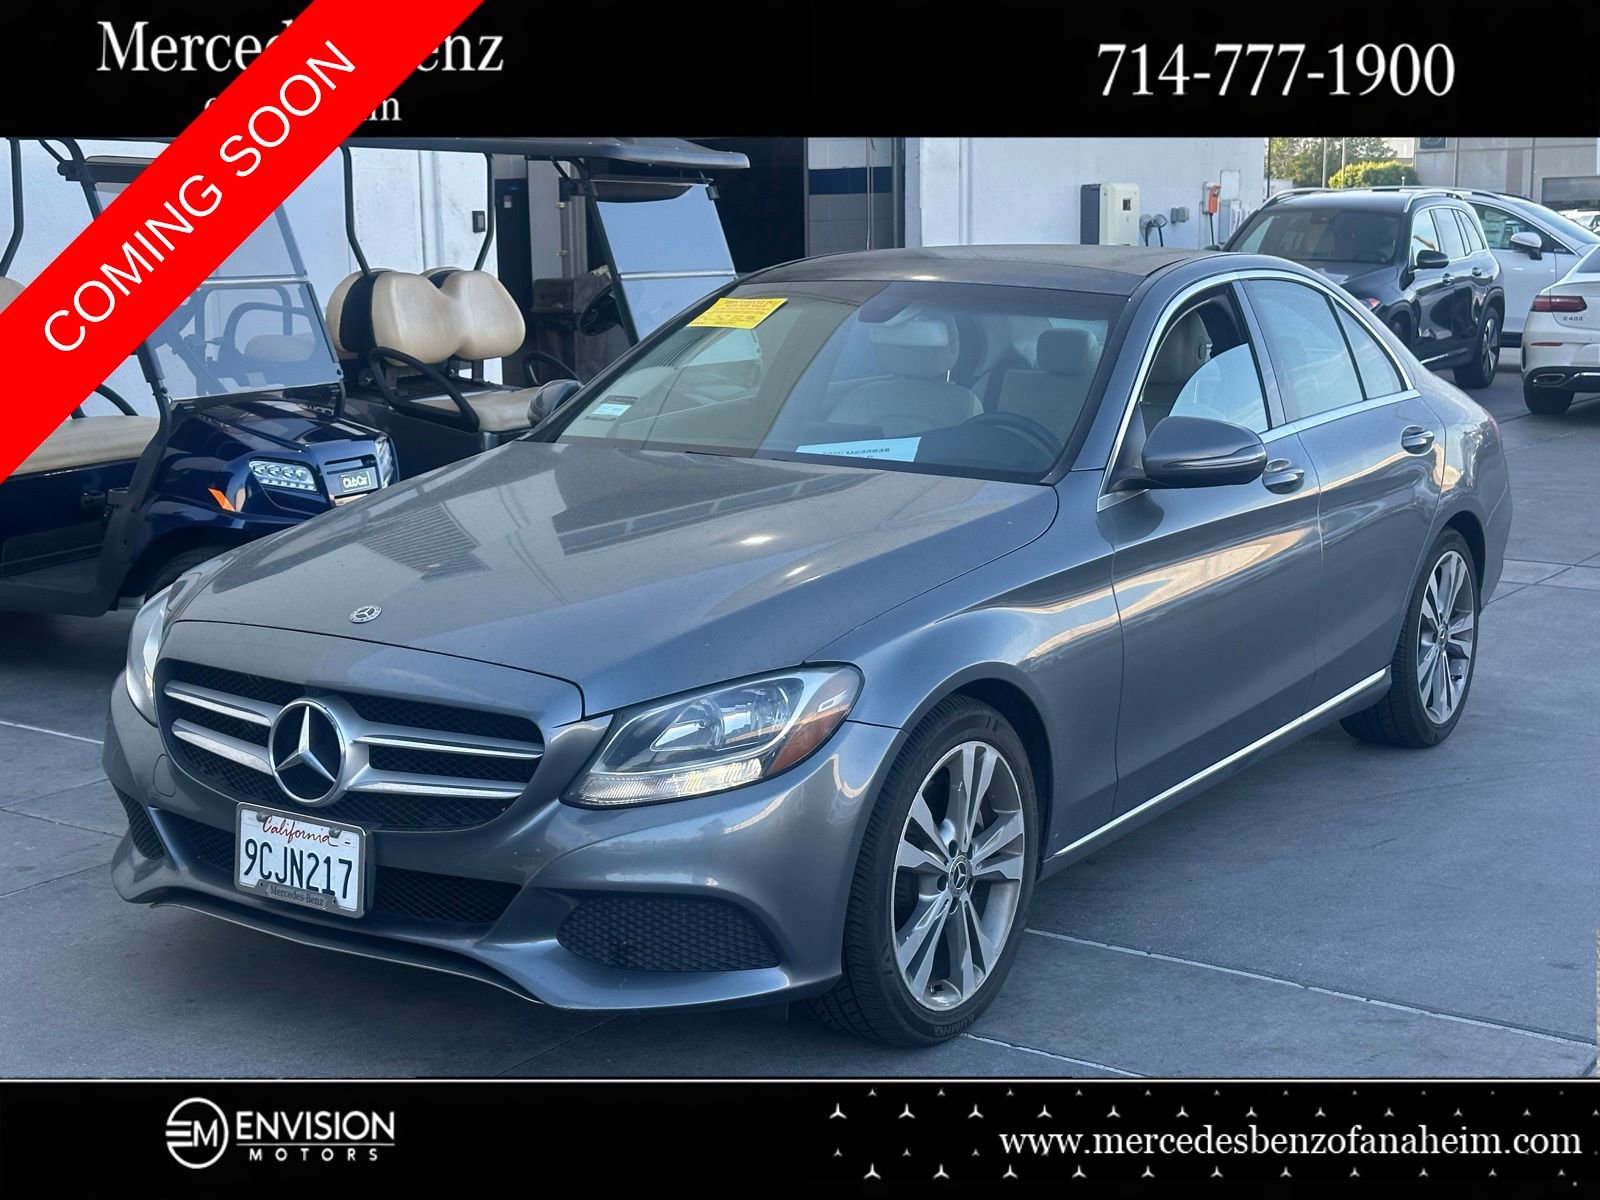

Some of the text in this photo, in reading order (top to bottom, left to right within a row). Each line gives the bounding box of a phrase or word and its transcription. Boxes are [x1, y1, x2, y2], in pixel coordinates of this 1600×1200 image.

[262, 815, 340, 848] California
[243, 838, 353, 900] 9CJN217
[270, 884, 326, 907] Mercedes-Benz
